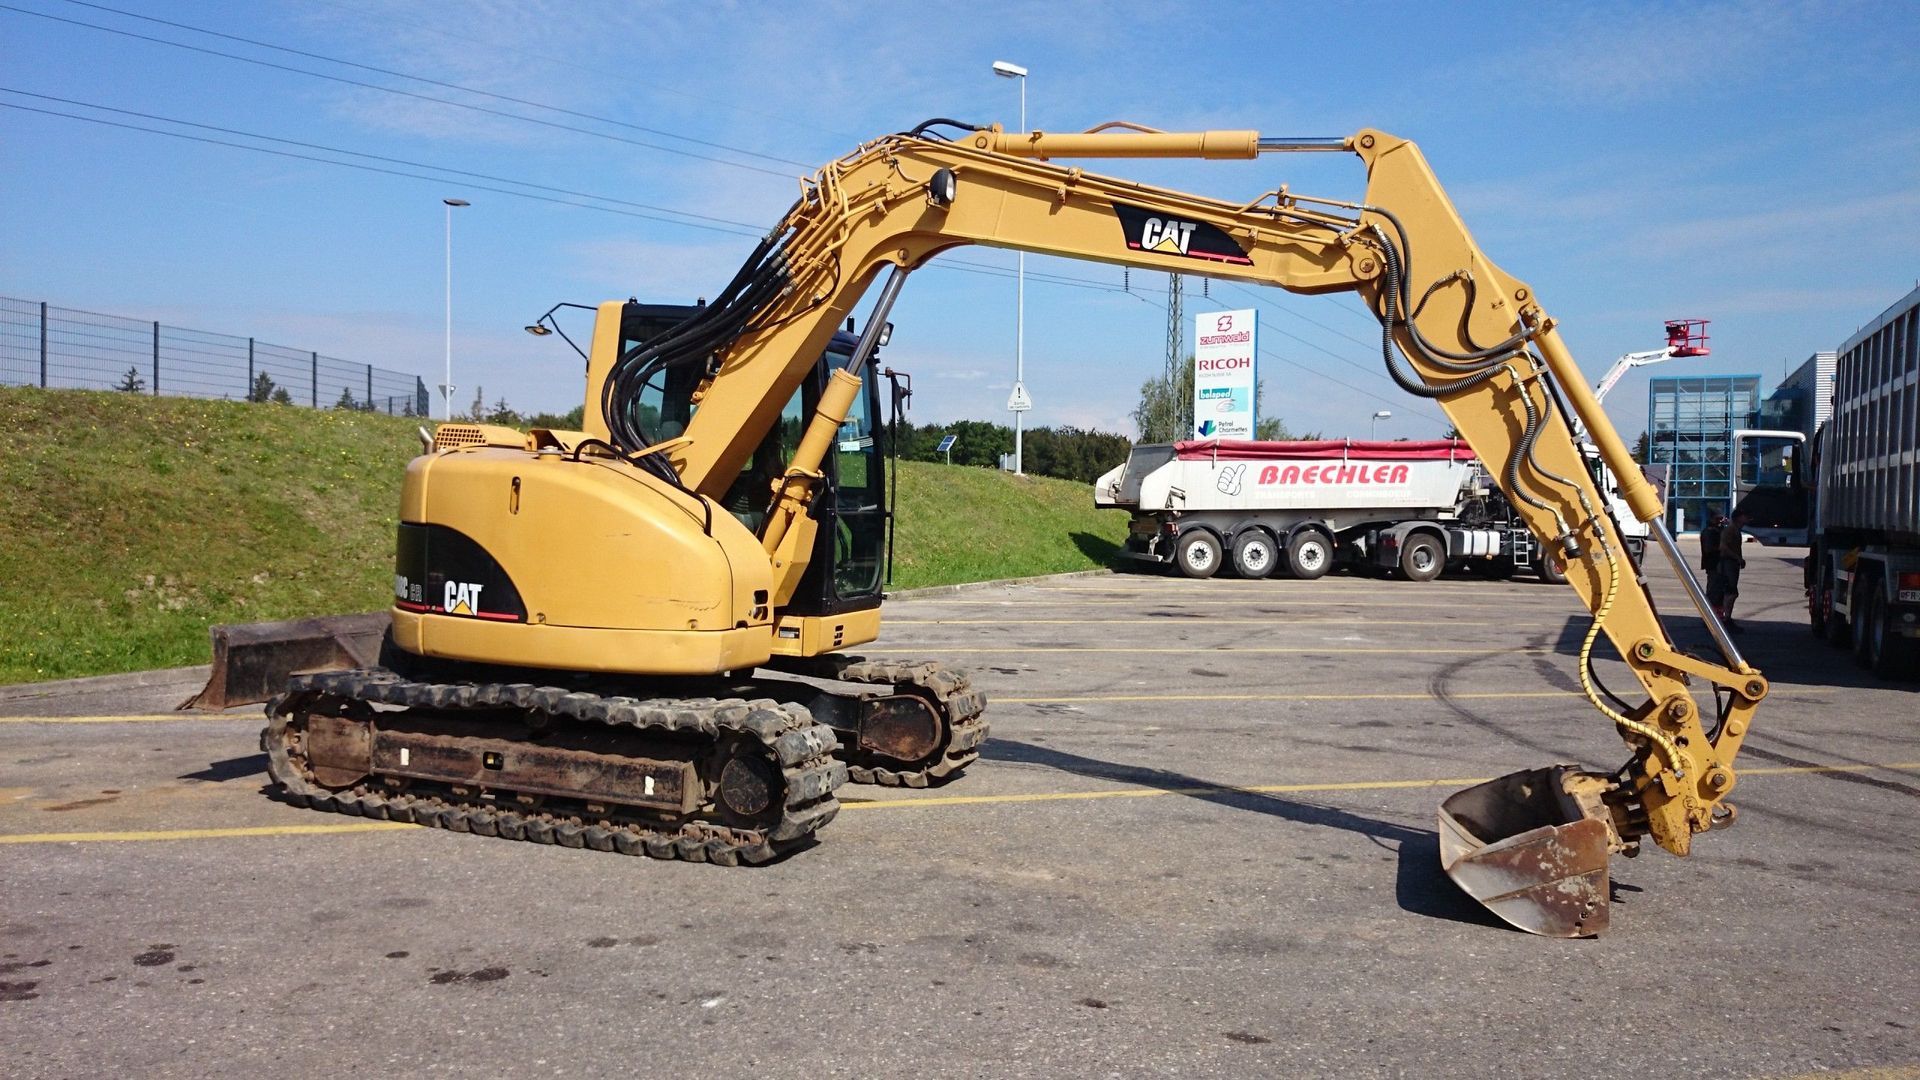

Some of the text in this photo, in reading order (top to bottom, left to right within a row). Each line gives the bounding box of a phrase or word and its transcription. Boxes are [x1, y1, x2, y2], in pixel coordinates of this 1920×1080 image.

[1141, 217, 1197, 255] CAT
[1199, 331, 1250, 346] zumwald
[1199, 357, 1250, 371] RICOH
[1258, 465, 1409, 485] BAECHLER
[444, 580, 483, 616] CAT
